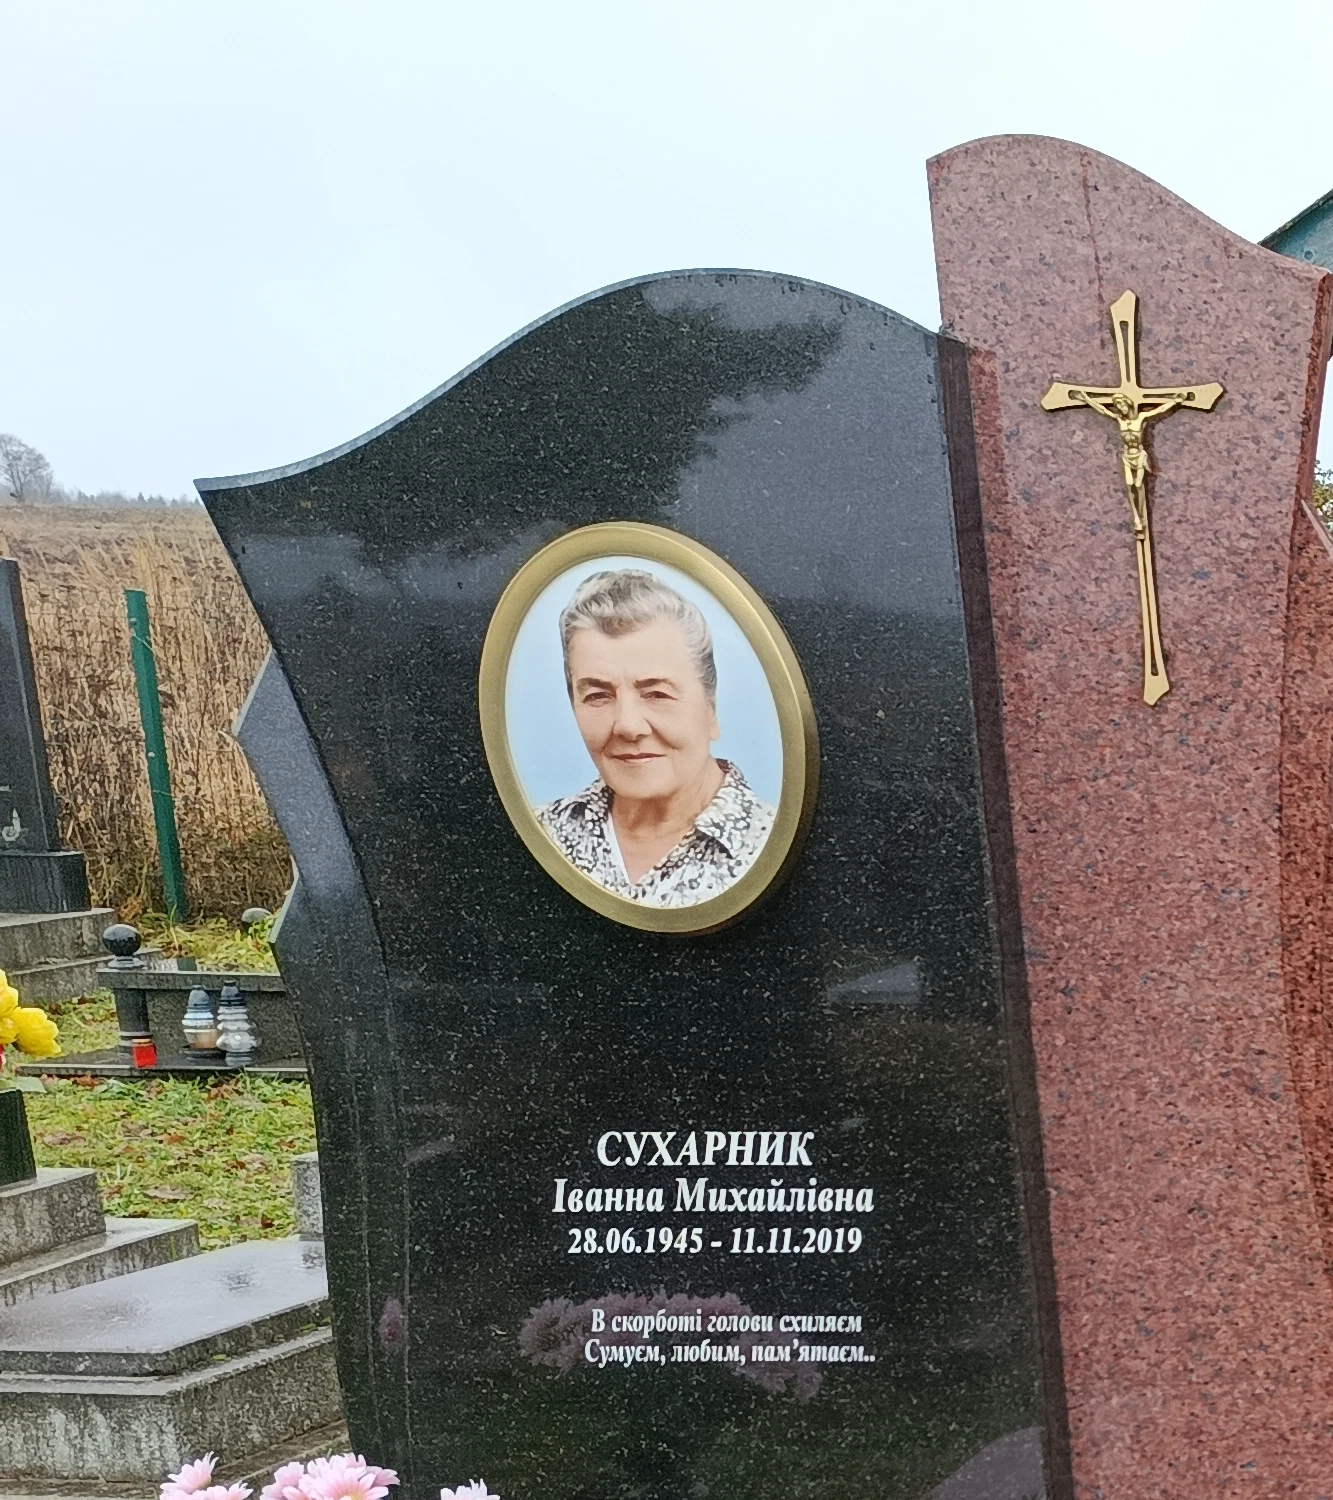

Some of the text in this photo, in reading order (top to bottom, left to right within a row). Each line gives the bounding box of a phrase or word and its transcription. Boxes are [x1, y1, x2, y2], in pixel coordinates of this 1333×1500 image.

[597, 1131, 814, 1166] СУХАРНИК
[552, 1178, 874, 1213] Іванна Михайлівна
[568, 1228, 703, 1254] 28.06.1945
[730, 1228, 862, 1254] 11.11.2019
[591, 1309, 862, 1337] В скорботі голови схиляєм
[585, 1339, 666, 1368] Сумуєм,
[671, 1339, 746, 1365] любим,
